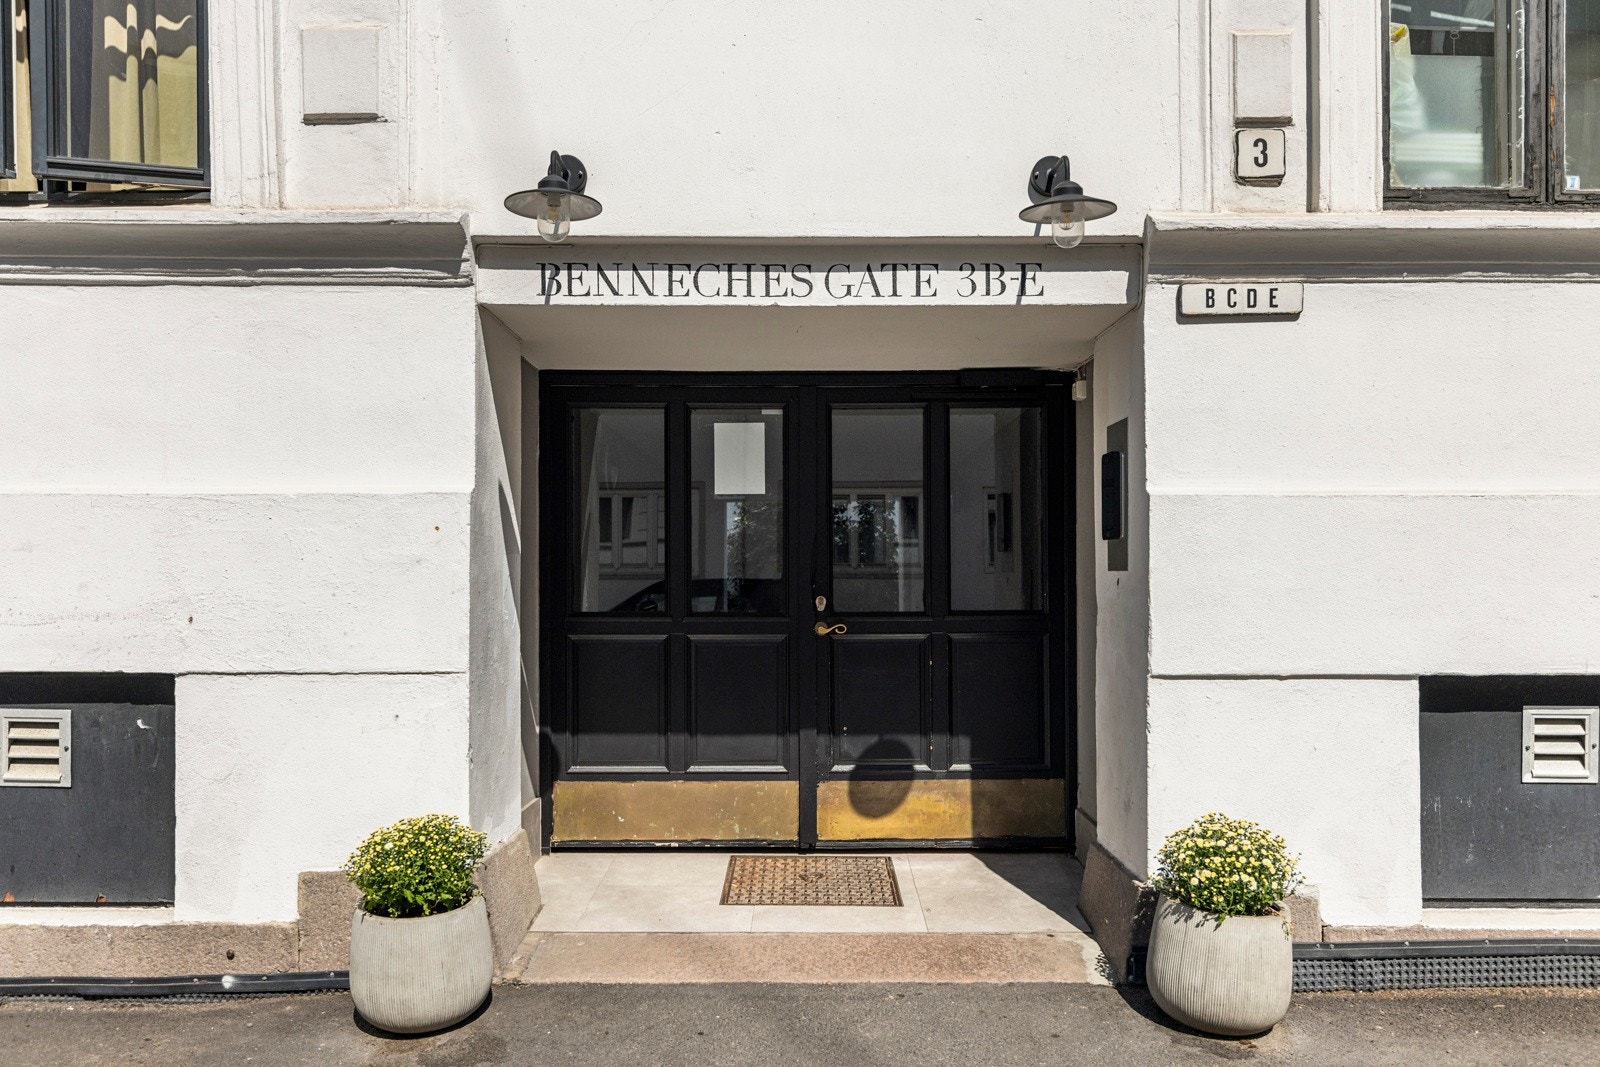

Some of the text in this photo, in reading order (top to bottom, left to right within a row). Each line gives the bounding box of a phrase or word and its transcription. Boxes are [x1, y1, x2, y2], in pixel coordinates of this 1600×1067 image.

[1253, 138, 1268, 167] 3
[536, 262, 1044, 299] BENNECHES GATE 3B-E
